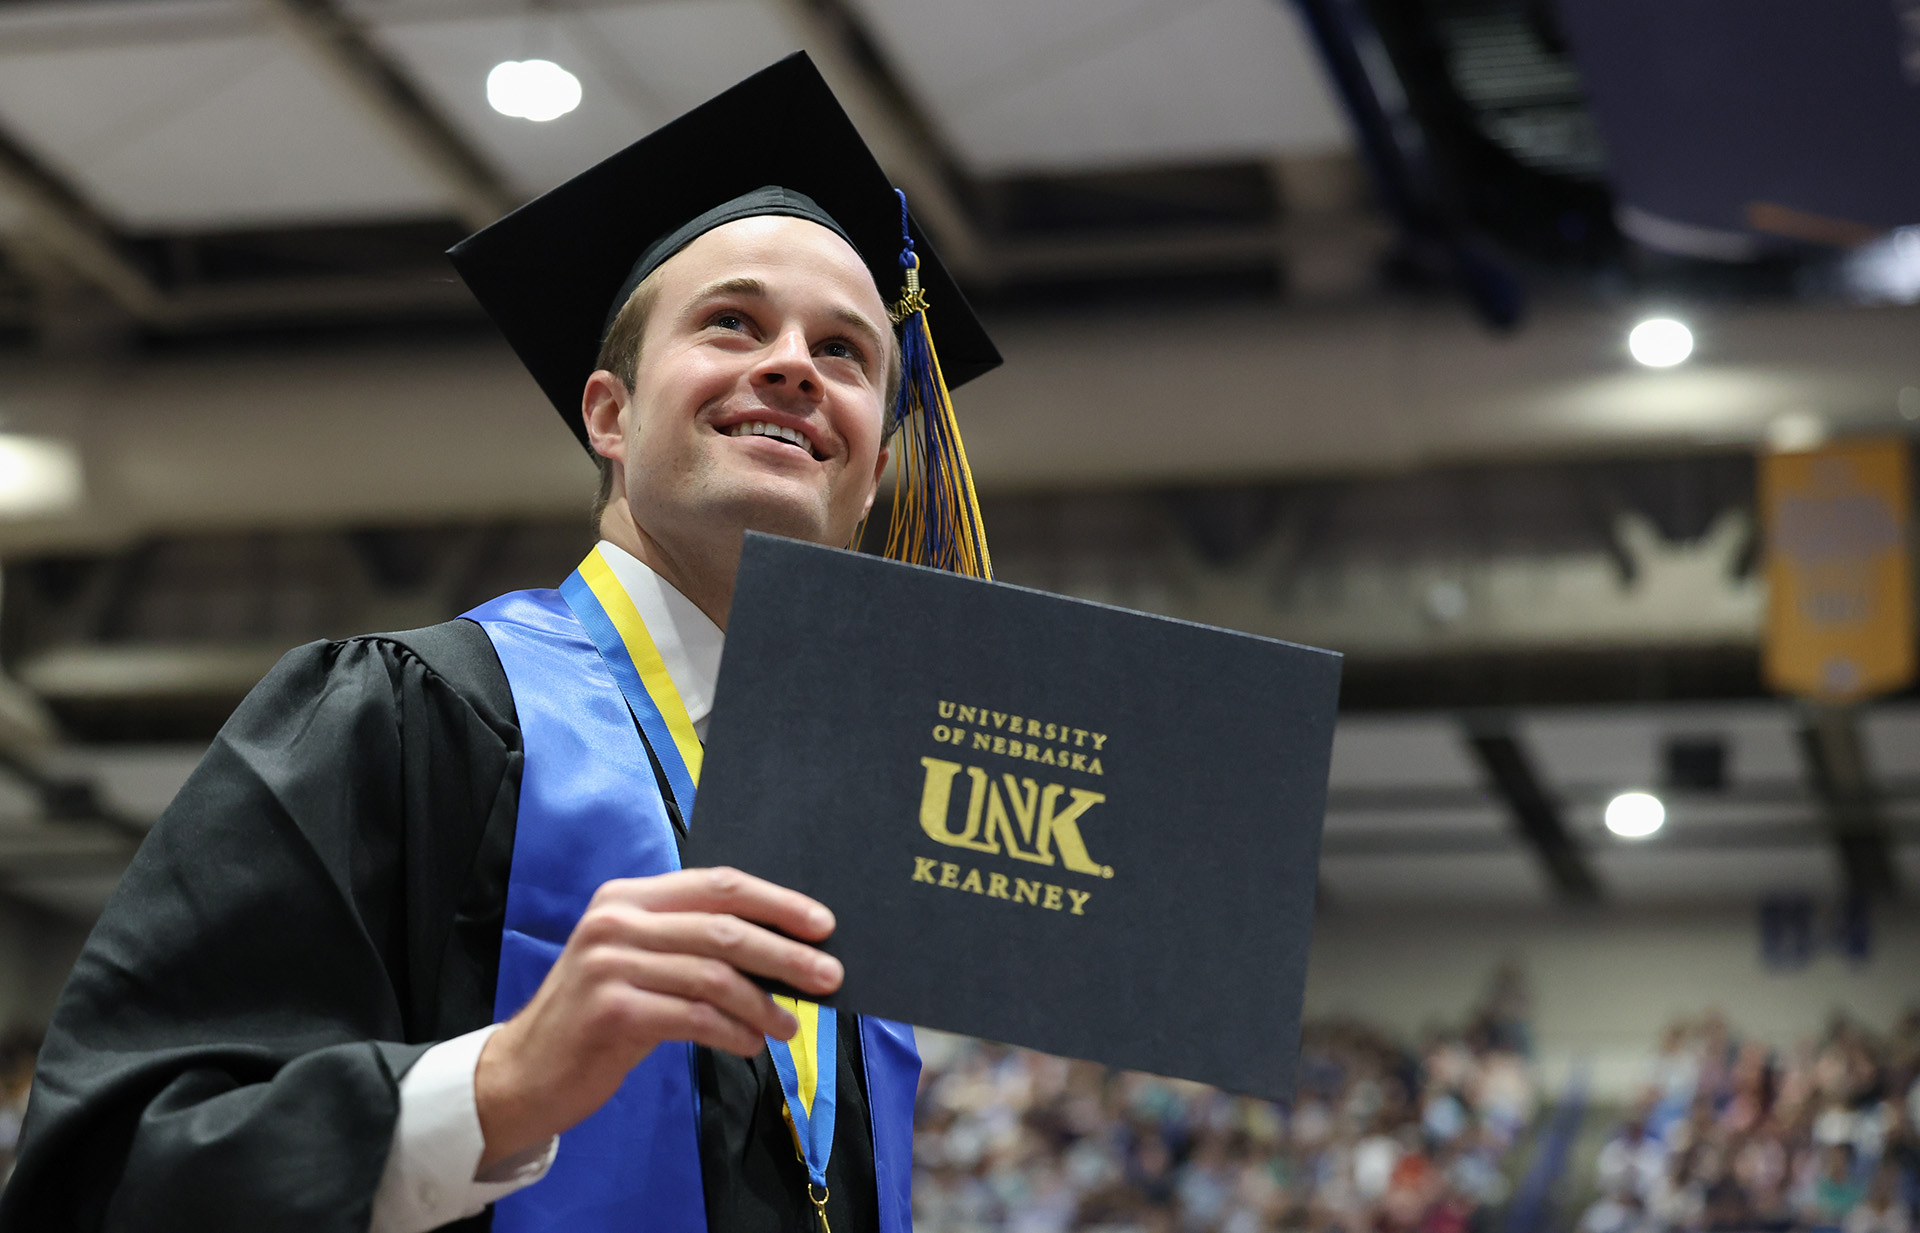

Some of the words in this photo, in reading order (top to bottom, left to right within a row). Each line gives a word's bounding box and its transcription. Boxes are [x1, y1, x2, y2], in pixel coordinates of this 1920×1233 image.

[932, 724, 966, 745] OF
[972, 732, 1104, 775] NEBRASKA
[938, 700, 1108, 750] UNIVERSITY
[919, 756, 1107, 878] UNK
[912, 856, 1091, 916] KEARNEY
